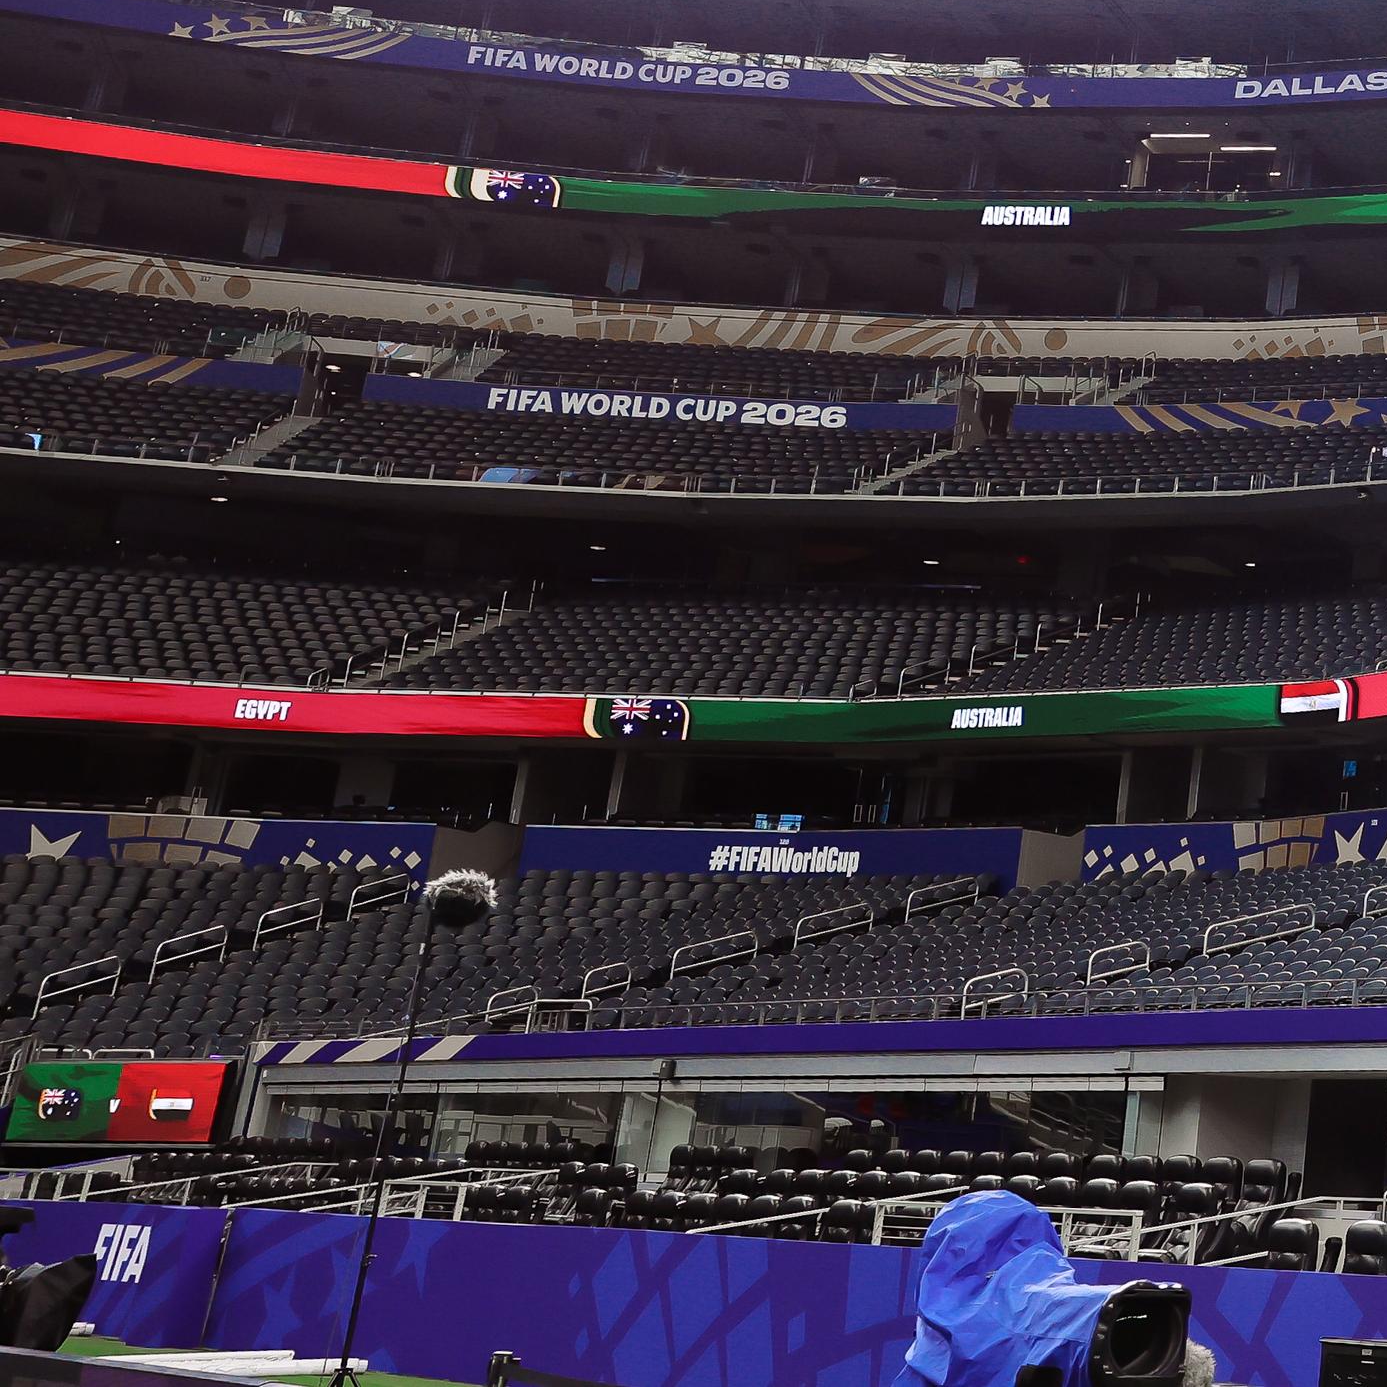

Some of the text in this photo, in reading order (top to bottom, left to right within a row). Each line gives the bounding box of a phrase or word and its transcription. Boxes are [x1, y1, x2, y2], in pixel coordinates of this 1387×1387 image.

[467, 46, 790, 90] FIFA WORLD CUP 2026
[981, 205, 1071, 226] AUSTRALIA
[487, 388, 847, 428] FIFA WORLD CUP 2026
[234, 700, 291, 721] EGYPT
[951, 706, 1022, 729] AUSTRALIA
[709, 845, 860, 877] #FIFAWorldCup
[93, 1223, 152, 1284] FIFA
